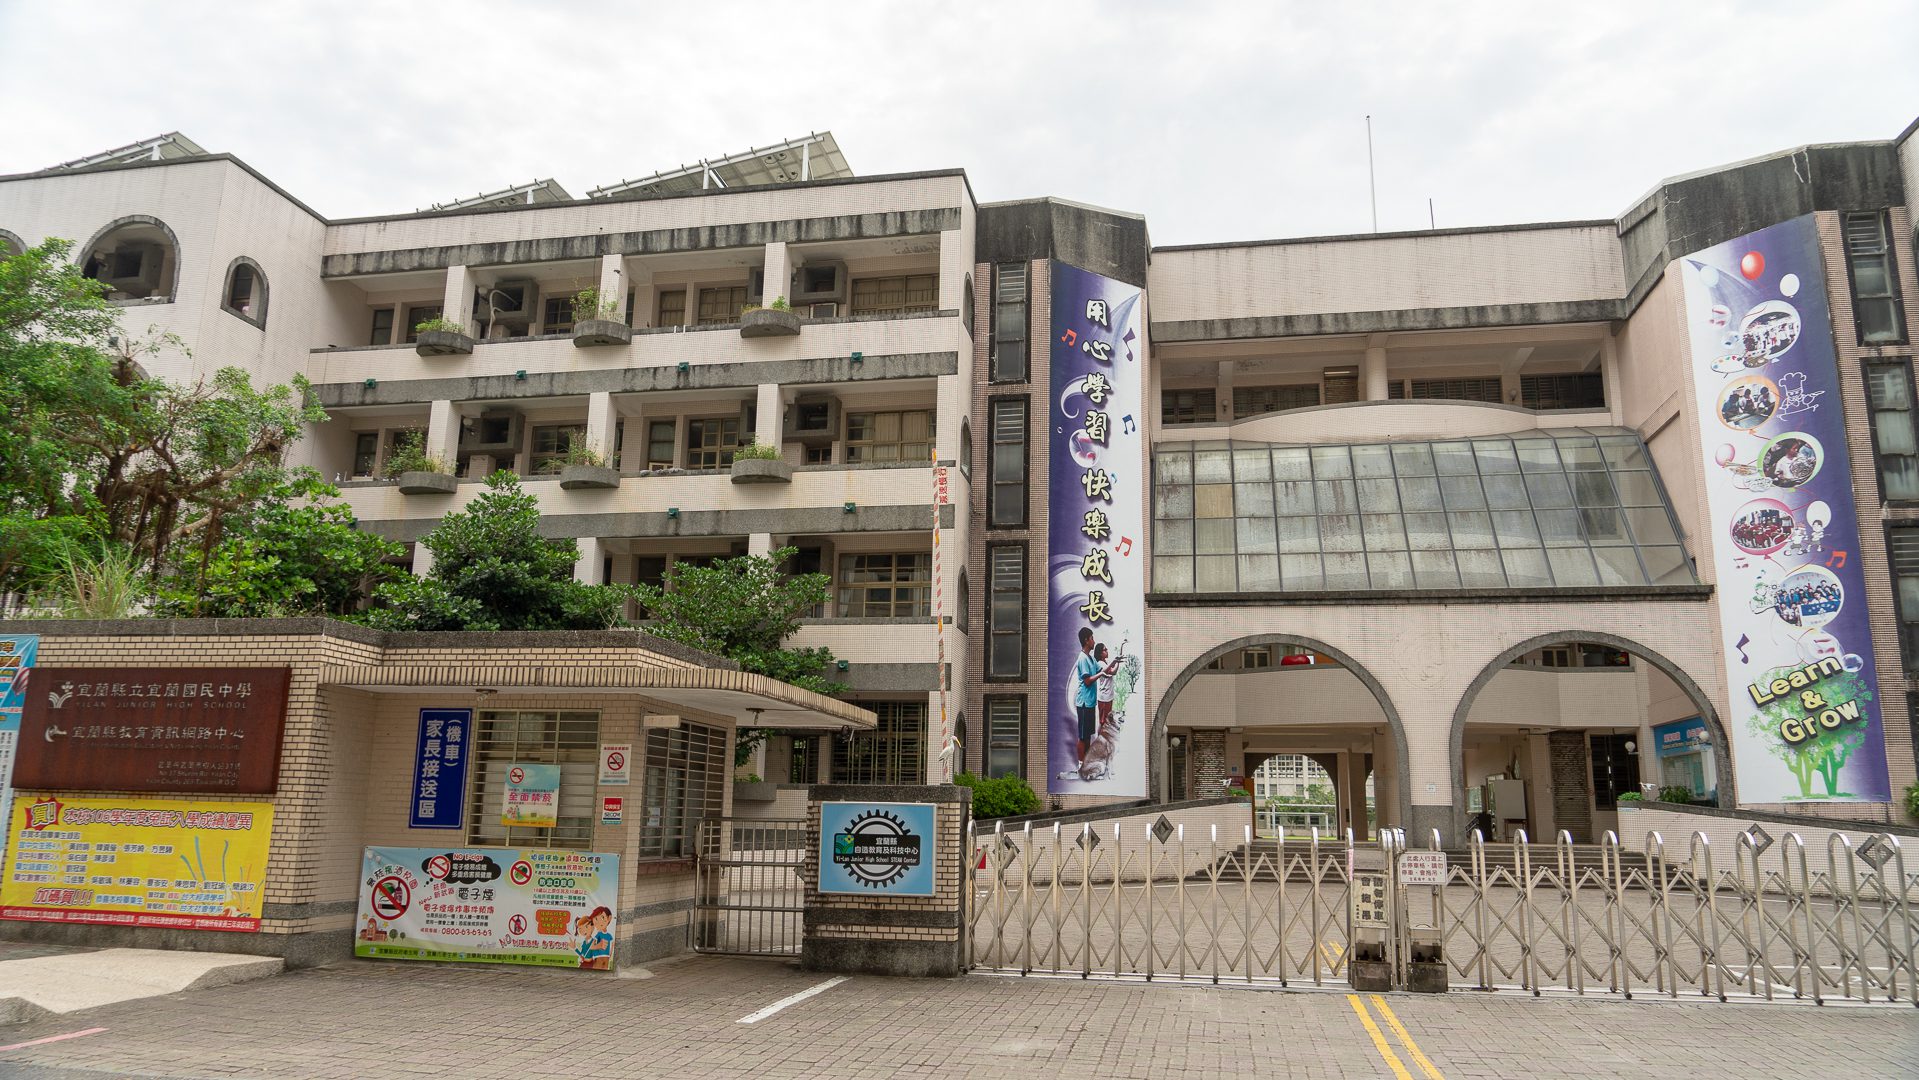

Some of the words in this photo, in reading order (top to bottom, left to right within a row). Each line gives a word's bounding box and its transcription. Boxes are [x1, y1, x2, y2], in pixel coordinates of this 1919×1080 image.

[1081, 299, 1112, 445] 用心學習
[1081, 468, 1112, 625] 快樂成長
[76, 682, 251, 698] 宜蘭縣立宜蘭國民中學
[1748, 656, 1842, 708] Learn
[1800, 690, 1828, 711] &
[1780, 699, 1861, 745] Grow
[72, 726, 245, 739] 宜蘭縣教育資訊網路中心
[418, 719, 444, 818] 家長接送區
[508, 792, 552, 802] 全面禁菸
[876, 838, 898, 846] 宜蘭縣
[854, 846, 919, 855] 自造教育及科技中心
[458, 888, 494, 901] 電子煙
[442, 928, 492, 936] 0800-63-63-63
